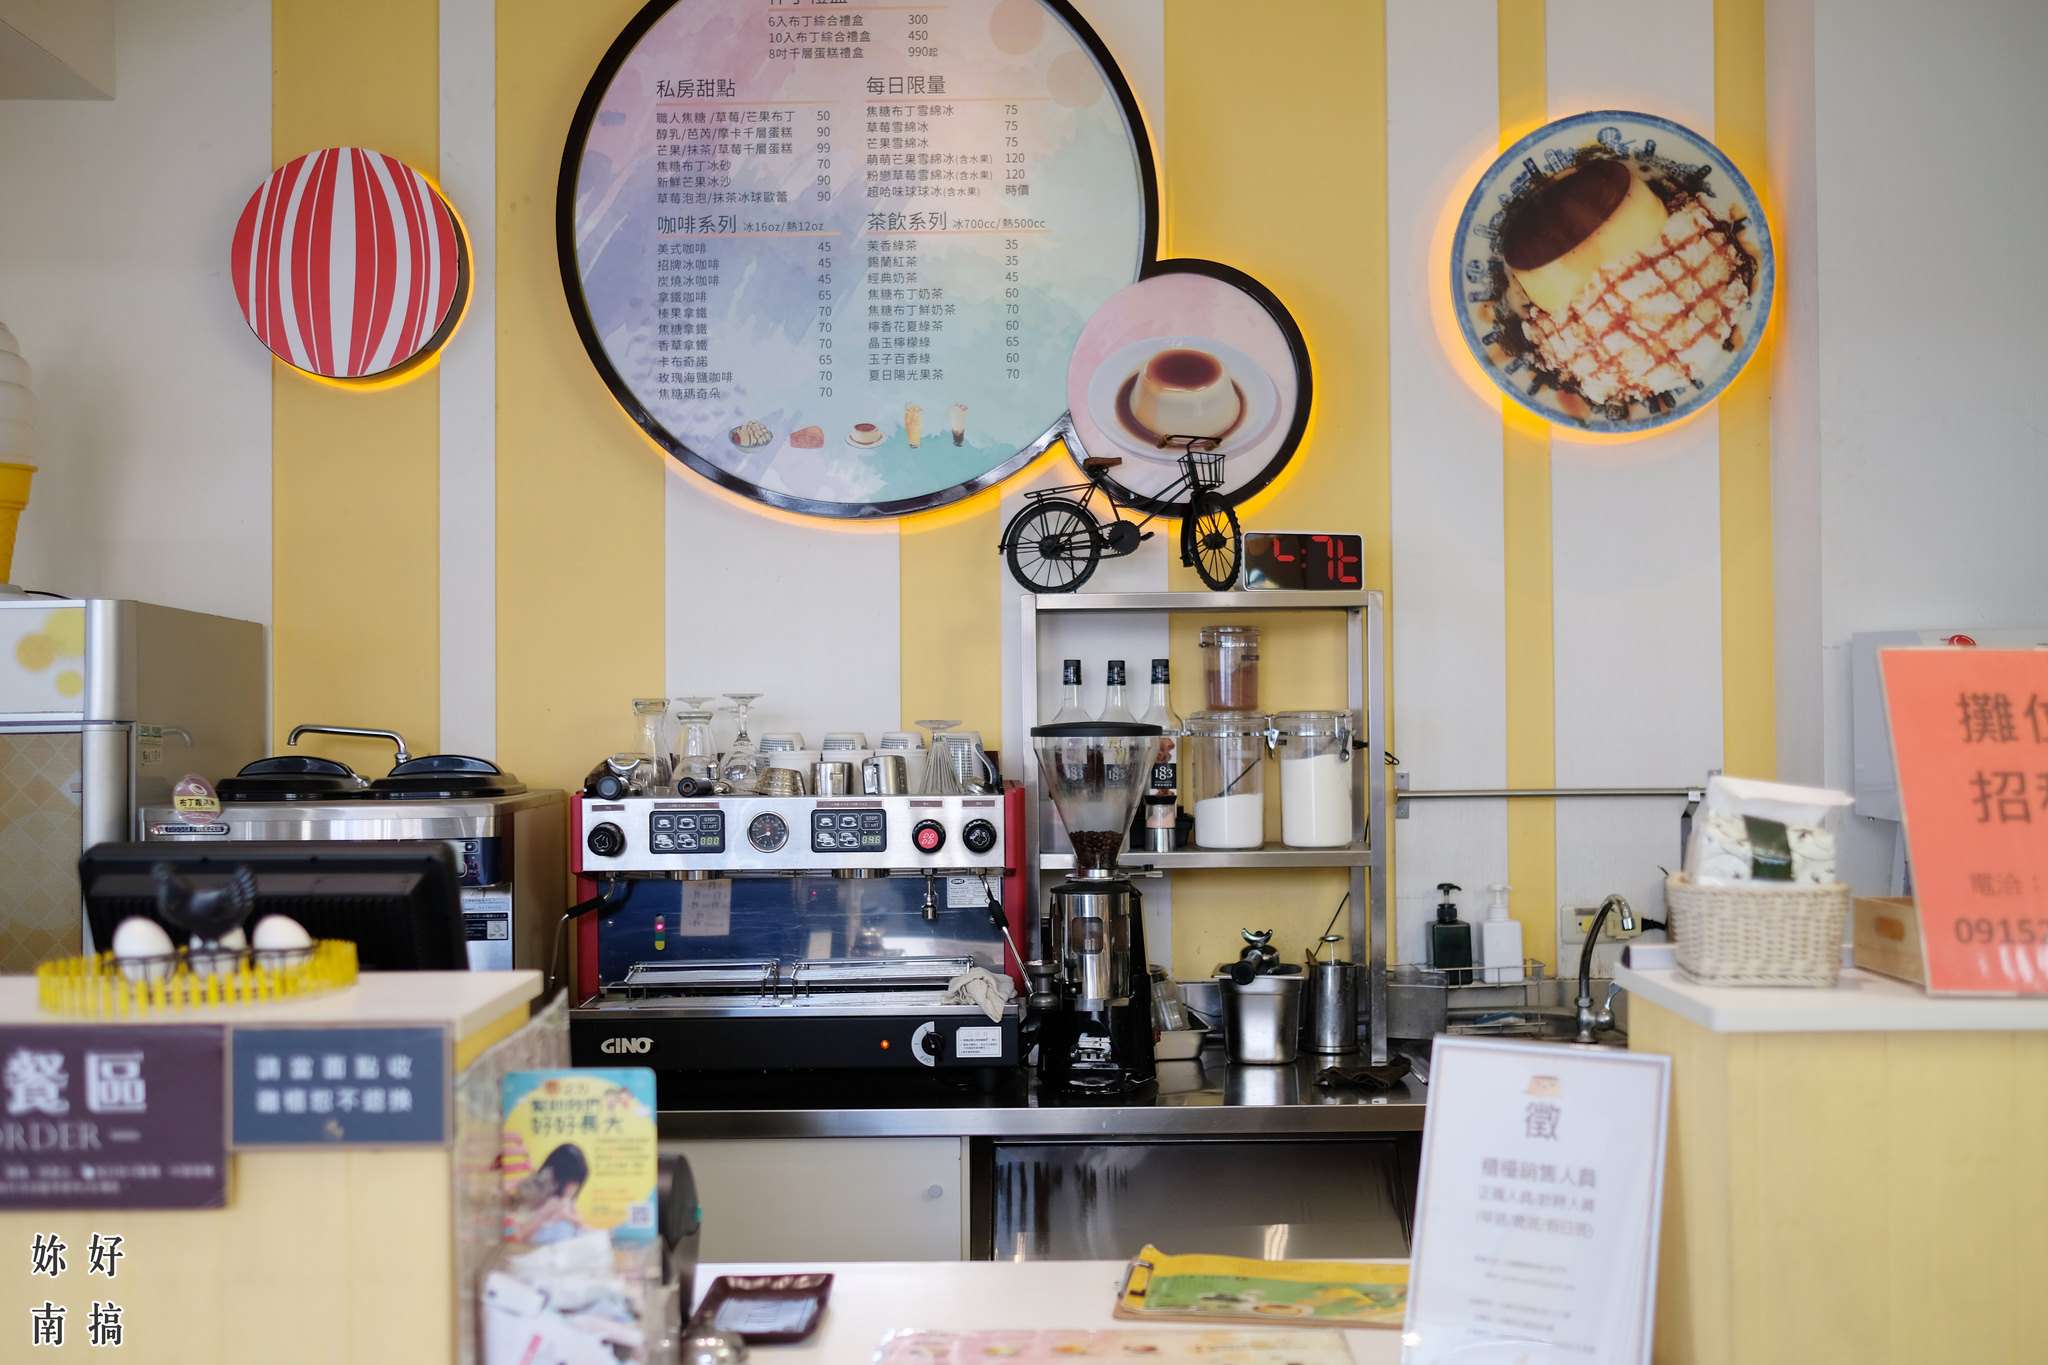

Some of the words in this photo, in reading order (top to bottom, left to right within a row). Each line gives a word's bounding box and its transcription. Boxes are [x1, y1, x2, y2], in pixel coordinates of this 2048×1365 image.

[768, 14, 864, 28] 6入布丁綜合禮盒
[908, 14, 928, 25] 300
[769, 30, 871, 44] 10入布丁綜合禮盒
[908, 30, 928, 41] 450
[768, 46, 864, 60] 8吋千層蛋糕禮盒
[656, 78, 736, 98] 私房甜點
[866, 76, 946, 96] 每日限量
[817, 110, 830, 121] 50
[867, 105, 954, 118] 焦糖布丁雪綿冰
[1005, 104, 1018, 114] 75
[817, 127, 830, 138] 90
[867, 121, 928, 134] 草莓雪綿冰
[1005, 121, 1018, 130] 75
[656, 143, 793, 157] 芒果/抹茶/草莓千層蛋糕
[817, 143, 830, 154] 99
[867, 138, 928, 150] 芒果雪綿冰
[1005, 137, 1018, 147] 75
[817, 160, 830, 170] 70
[1006, 153, 1024, 164] 120
[1006, 169, 1024, 180] 120
[657, 176, 731, 188] 新鮮芒果冰沙
[817, 176, 830, 186] 90
[1006, 184, 1029, 196] 時價
[817, 192, 830, 202] 90
[657, 214, 736, 234] 咖啡系列
[744, 221, 824, 232] 冰16oz/熱12oz
[867, 212, 946, 231] 茶飲系列
[952, 218, 1046, 230] 冰700cc/熱500cc
[657, 243, 706, 255] 美式咖啡
[818, 242, 832, 252] 45
[867, 240, 918, 252] 茉香綠茶
[1006, 240, 1018, 250] 35
[658, 259, 720, 271] 招牌冰咖啡
[818, 258, 832, 268] 45
[1006, 256, 1018, 266] 35
[818, 274, 832, 284] 45
[868, 272, 918, 284] 經典奶茶
[1006, 272, 1018, 282] 45
[658, 292, 707, 303] 拿鐵咖啡
[818, 290, 832, 300] 65
[868, 288, 944, 300] 焦糖布丁奶茶
[1006, 288, 1019, 298] 60
[818, 306, 832, 316] 70
[868, 304, 956, 316] 焦糖布丁鮮奶茶
[1006, 304, 1019, 314] 70
[658, 323, 708, 335] 焦糖拿鐵
[819, 322, 832, 332] 70
[1006, 320, 1019, 330] 60
[658, 340, 708, 352] 香草拿鐵
[819, 338, 832, 349] 70
[1006, 336, 1020, 347] 65
[658, 356, 708, 368] 卡布奇諾
[819, 355, 832, 365] 65
[1006, 352, 1020, 363] 60
[658, 372, 734, 384] 玫瑰海鹽咖啡
[820, 371, 832, 381] 70
[868, 370, 944, 382] 夏日陽光果茶
[1007, 369, 1020, 380] 70
[658, 388, 720, 400] 焦糖瑪奇朵
[820, 387, 832, 398] 70
[1970, 771, 2048, 824] 招
[600, 1037, 654, 1054] GINO
[0, 1121, 103, 1151] RDER
